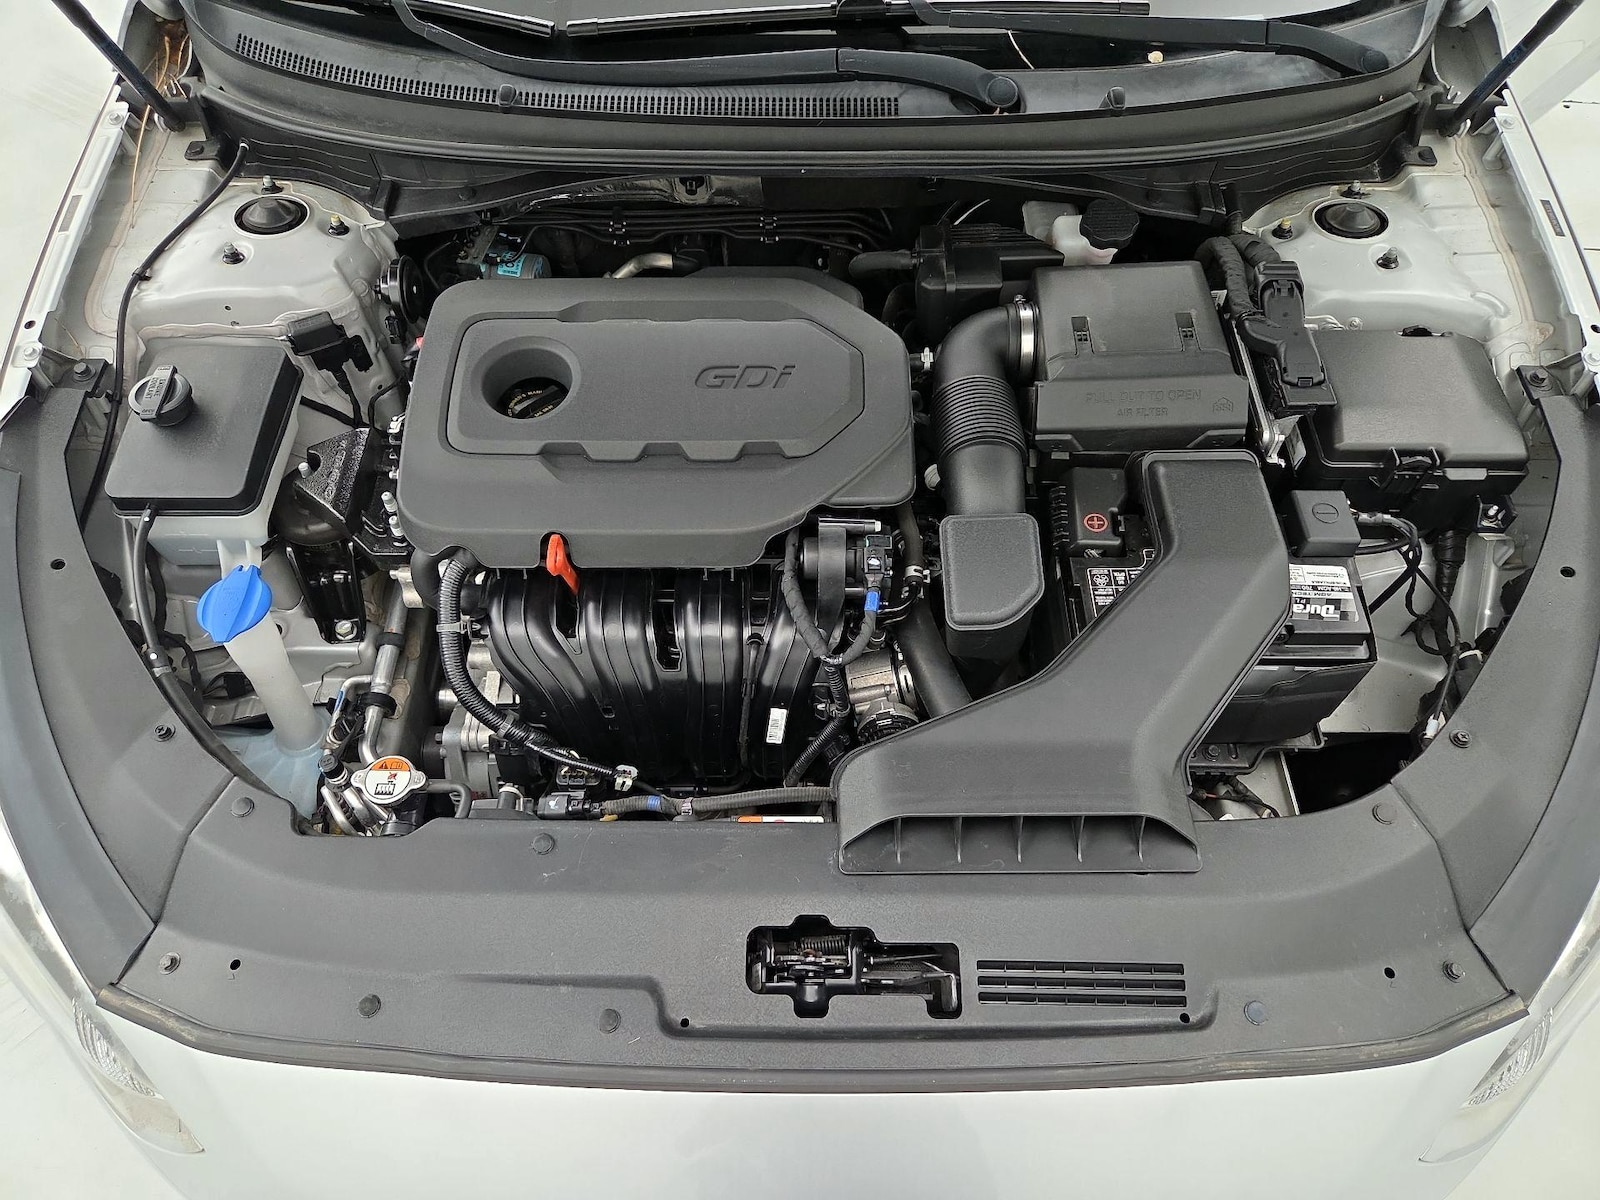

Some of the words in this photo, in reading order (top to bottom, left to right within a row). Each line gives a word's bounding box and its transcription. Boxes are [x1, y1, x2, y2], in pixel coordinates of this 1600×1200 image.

[694, 365, 796, 389] GDi
[1147, 390, 1164, 401] TO
[1167, 388, 1202, 401] OPEN
[1117, 408, 1133, 417] AIR
[1136, 407, 1169, 417] FILTER
[1293, 603, 1340, 618] Dura
